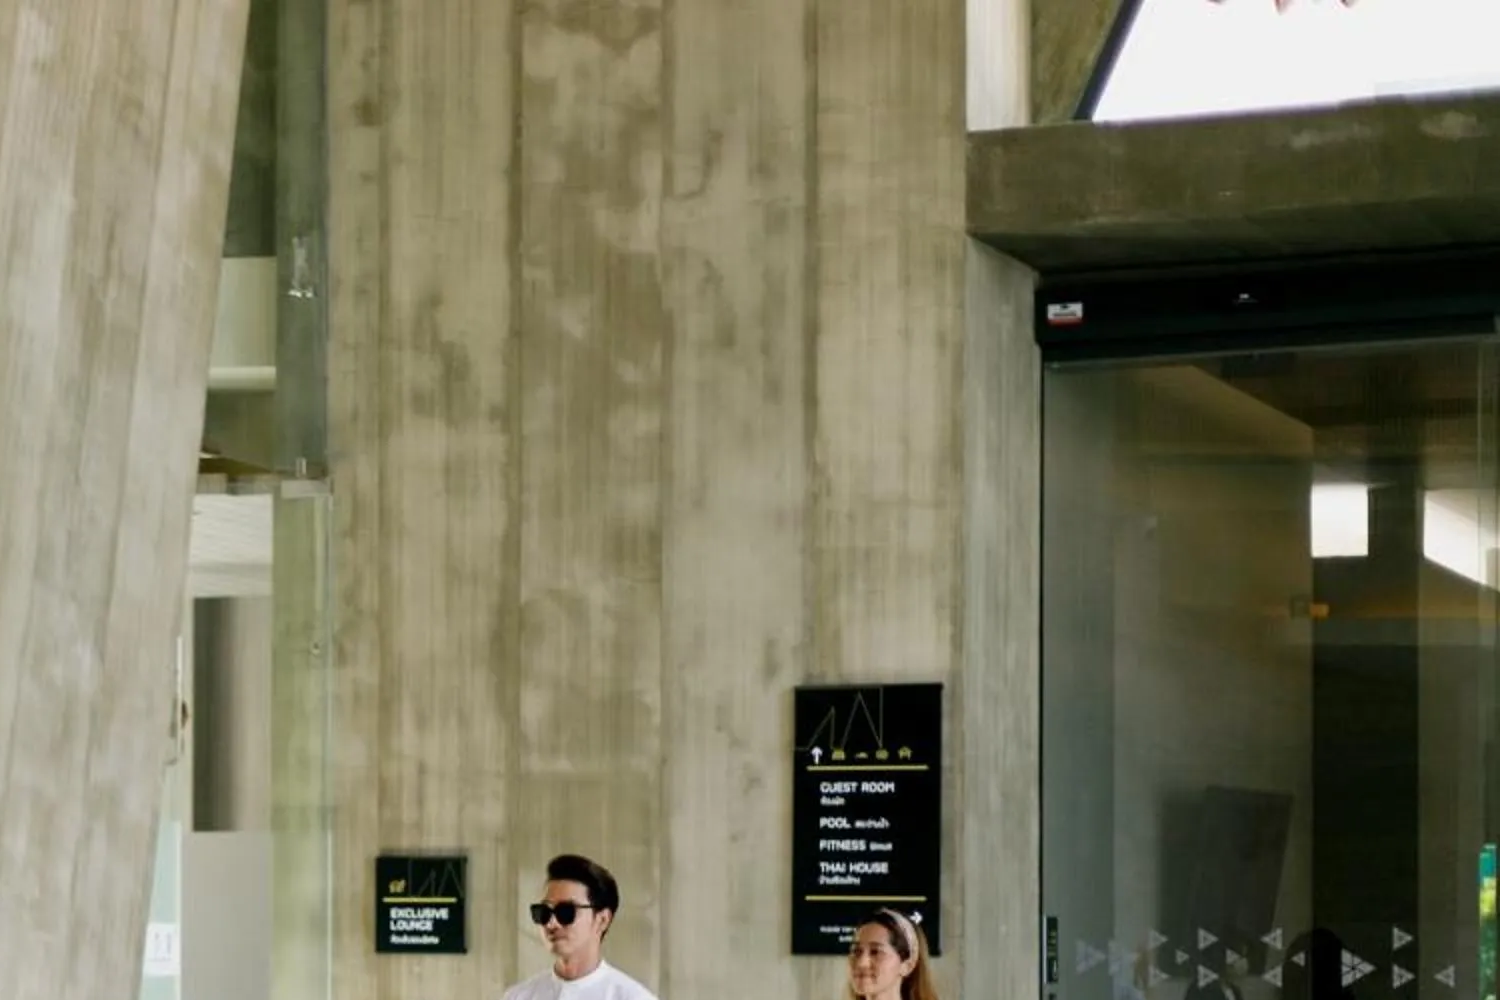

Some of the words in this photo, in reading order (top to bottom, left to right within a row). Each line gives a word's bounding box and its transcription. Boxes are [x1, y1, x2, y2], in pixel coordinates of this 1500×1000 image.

[820, 781, 858, 794] GUEST
[861, 781, 895, 794] ROOM
[819, 816, 851, 829] POOL
[819, 839, 867, 852] FITNESS
[819, 861, 846, 873] THAI
[849, 861, 889, 874] HOUSE
[389, 907, 449, 920] EXCLUSIVE
[389, 919, 434, 932] LOUNGE
